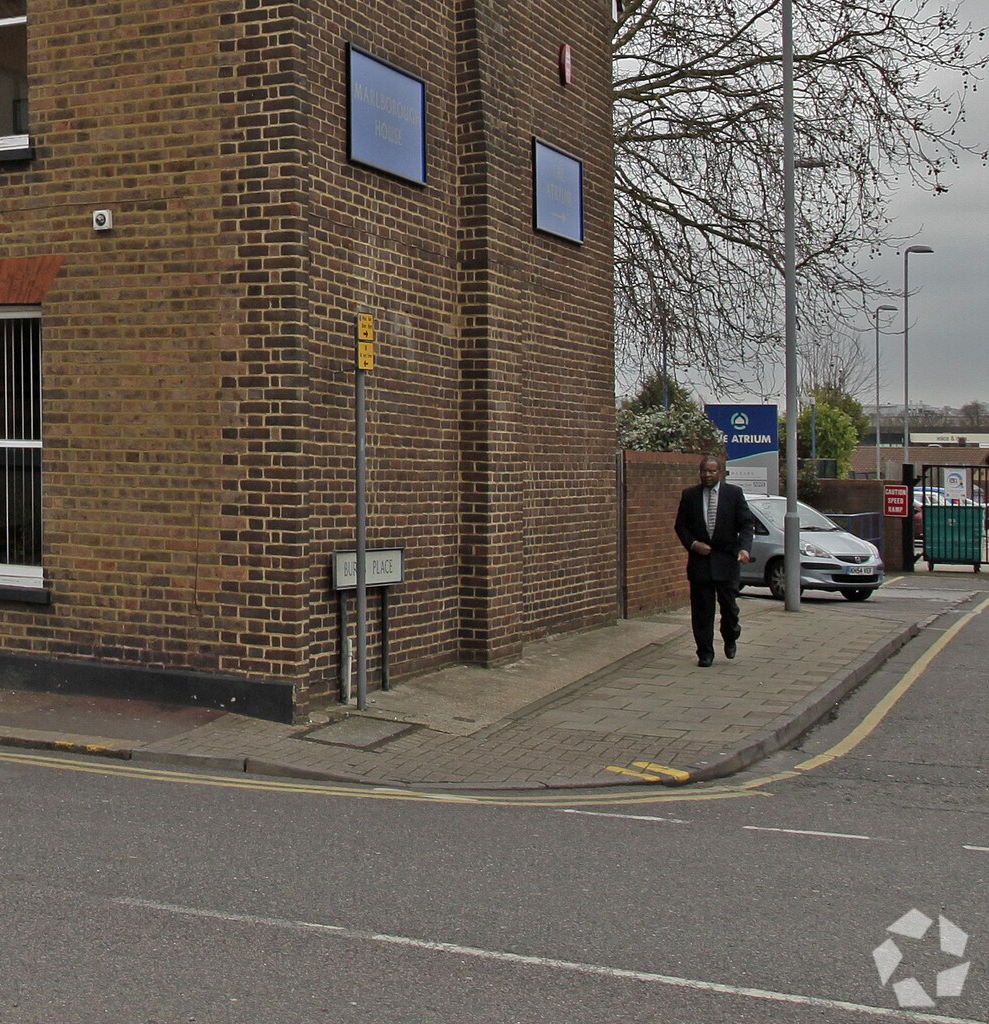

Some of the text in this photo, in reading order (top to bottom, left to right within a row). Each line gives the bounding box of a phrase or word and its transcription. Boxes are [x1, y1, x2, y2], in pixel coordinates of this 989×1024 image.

[354, 82, 421, 125] MARLBOROUGH
[375, 119, 403, 146] HOUSE
[731, 434, 771, 444] ATRIUM
[887, 497, 904, 505] SPEED
[372, 559, 393, 575] PLACE
